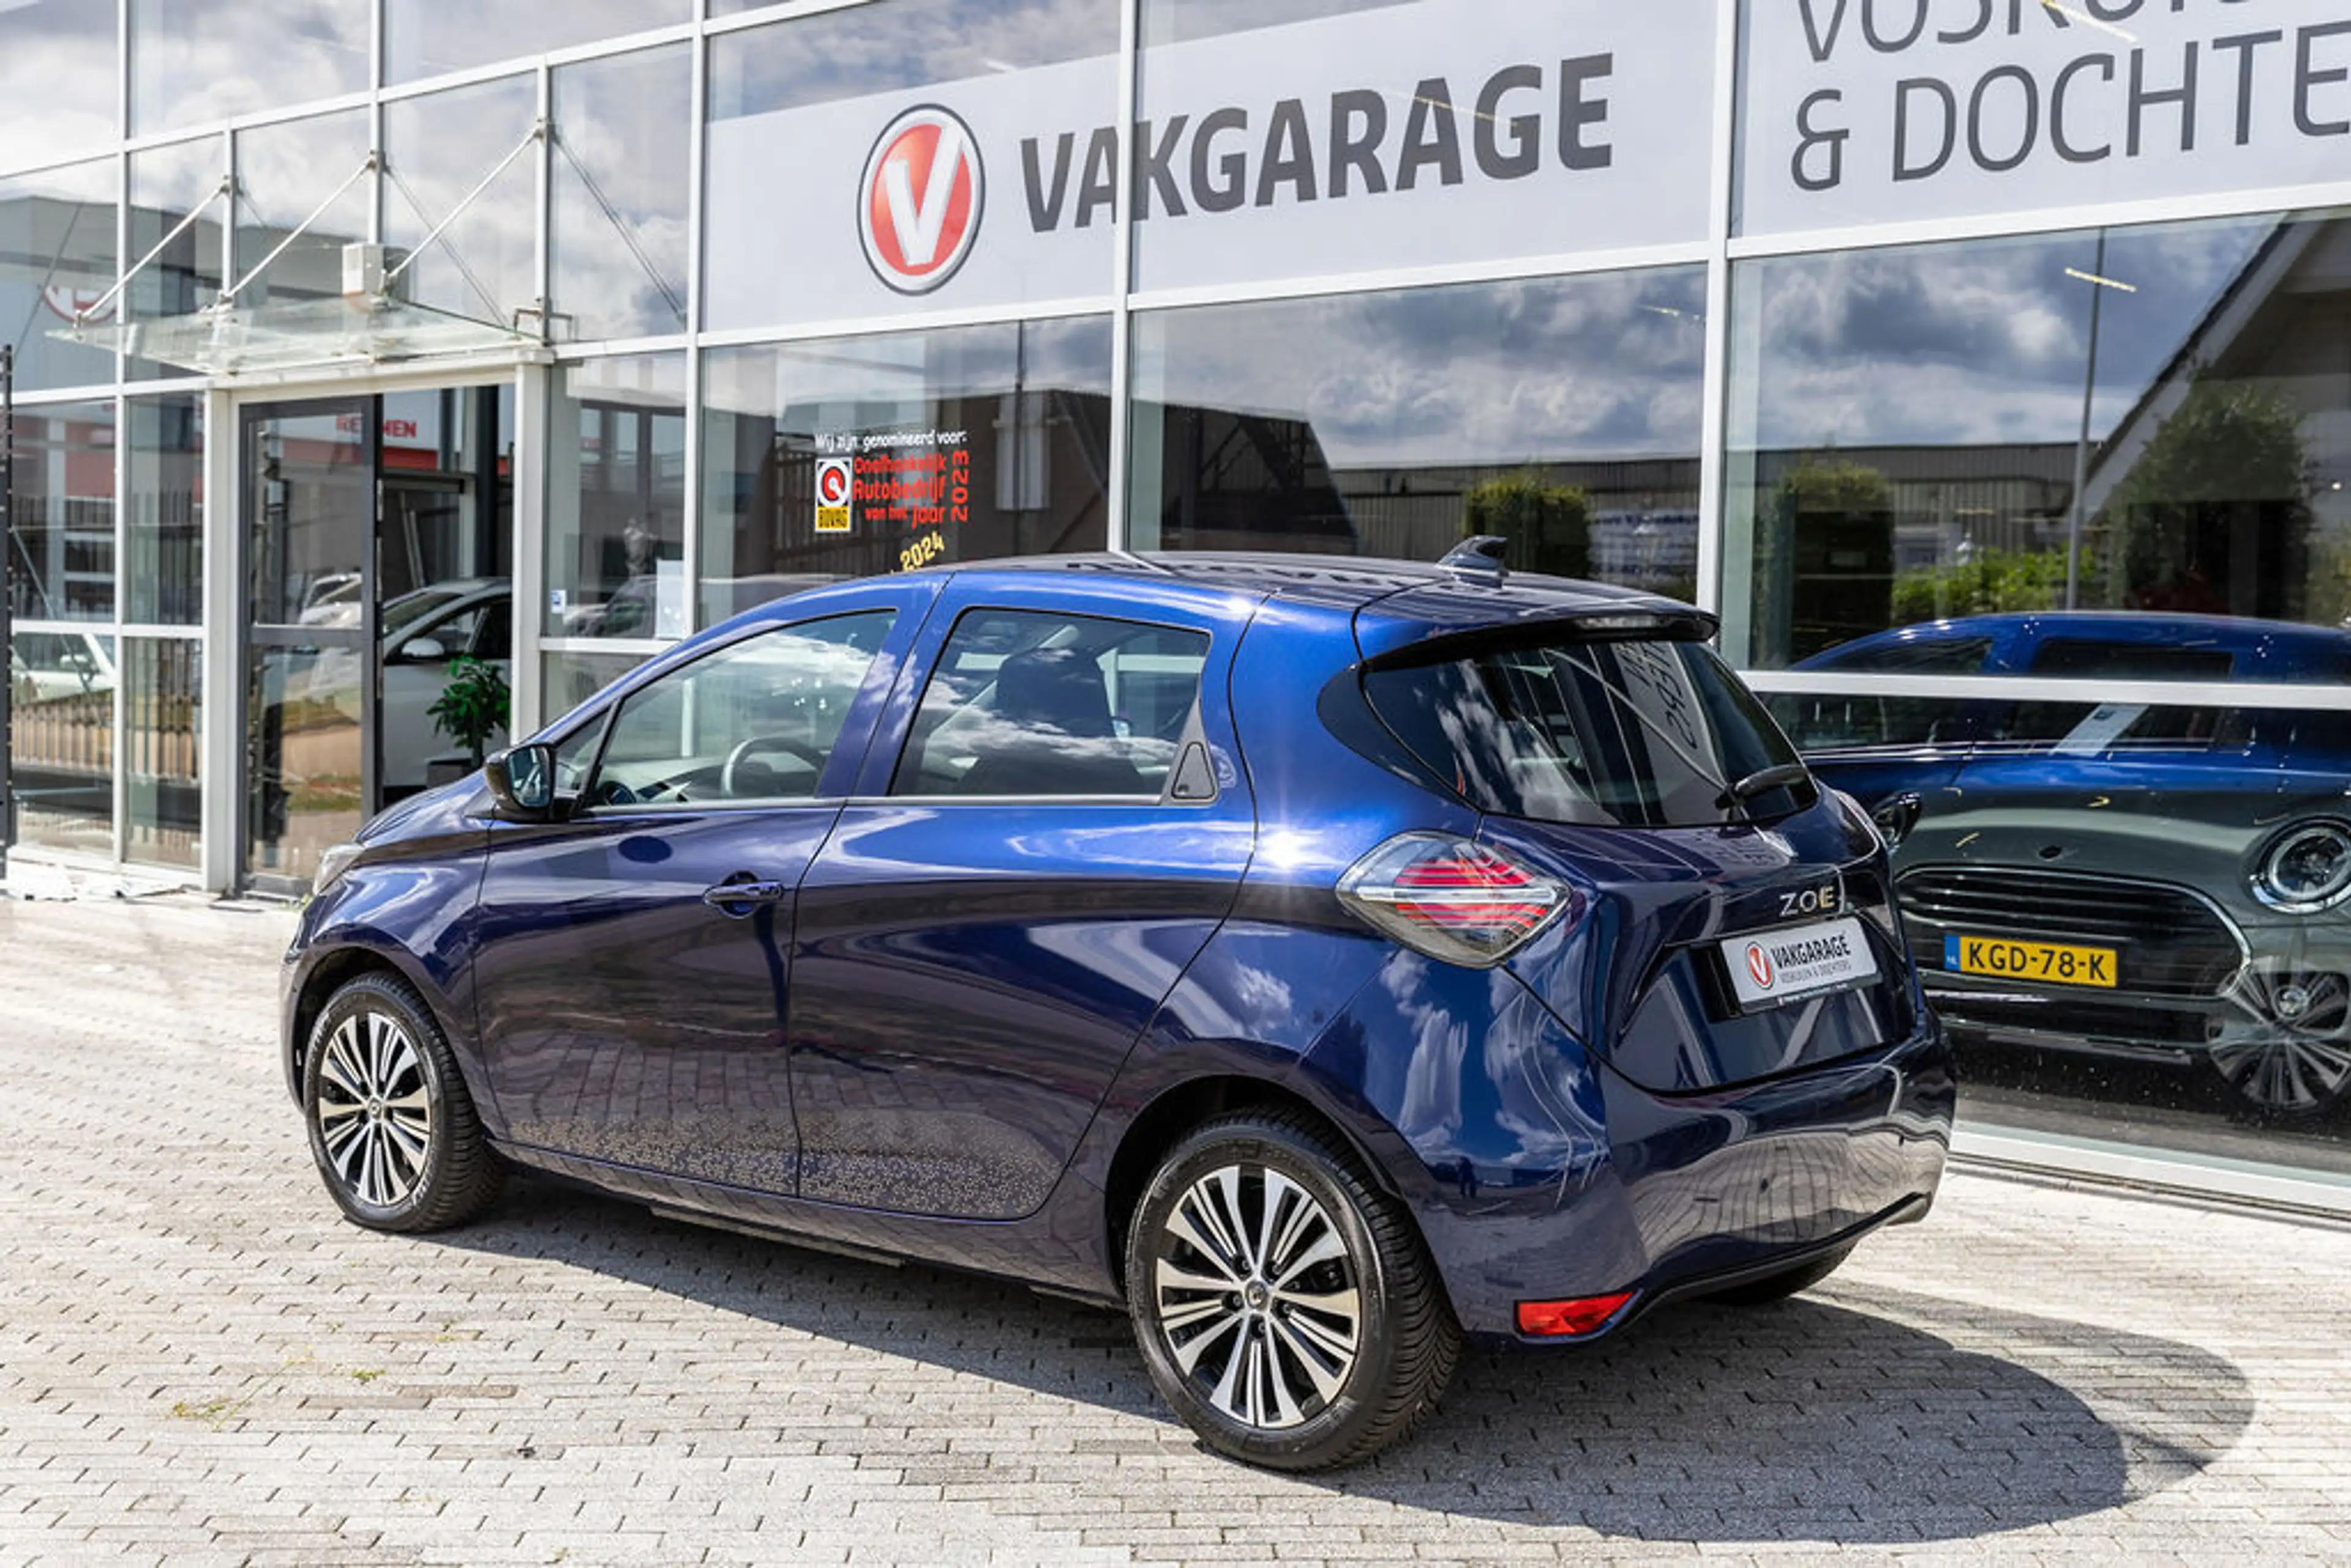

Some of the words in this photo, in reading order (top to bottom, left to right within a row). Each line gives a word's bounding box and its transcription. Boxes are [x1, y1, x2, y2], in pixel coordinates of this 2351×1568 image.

[1790, 88, 1850, 191] &
[1892, 20, 2351, 182] DOCHTE
[1020, 52, 1613, 233] VAKGARAGE
[863, 429, 935, 452] genomineerd
[937, 431, 967, 445] voor:
[852, 475, 947, 503] Autobedrijf
[951, 449, 970, 522] 2023
[899, 530, 945, 572] 2024
[1779, 886, 1835, 917] ZOE
[1770, 934, 1851, 969] VAKGARAGE
[1968, 942, 2107, 981] KGD-78-K
